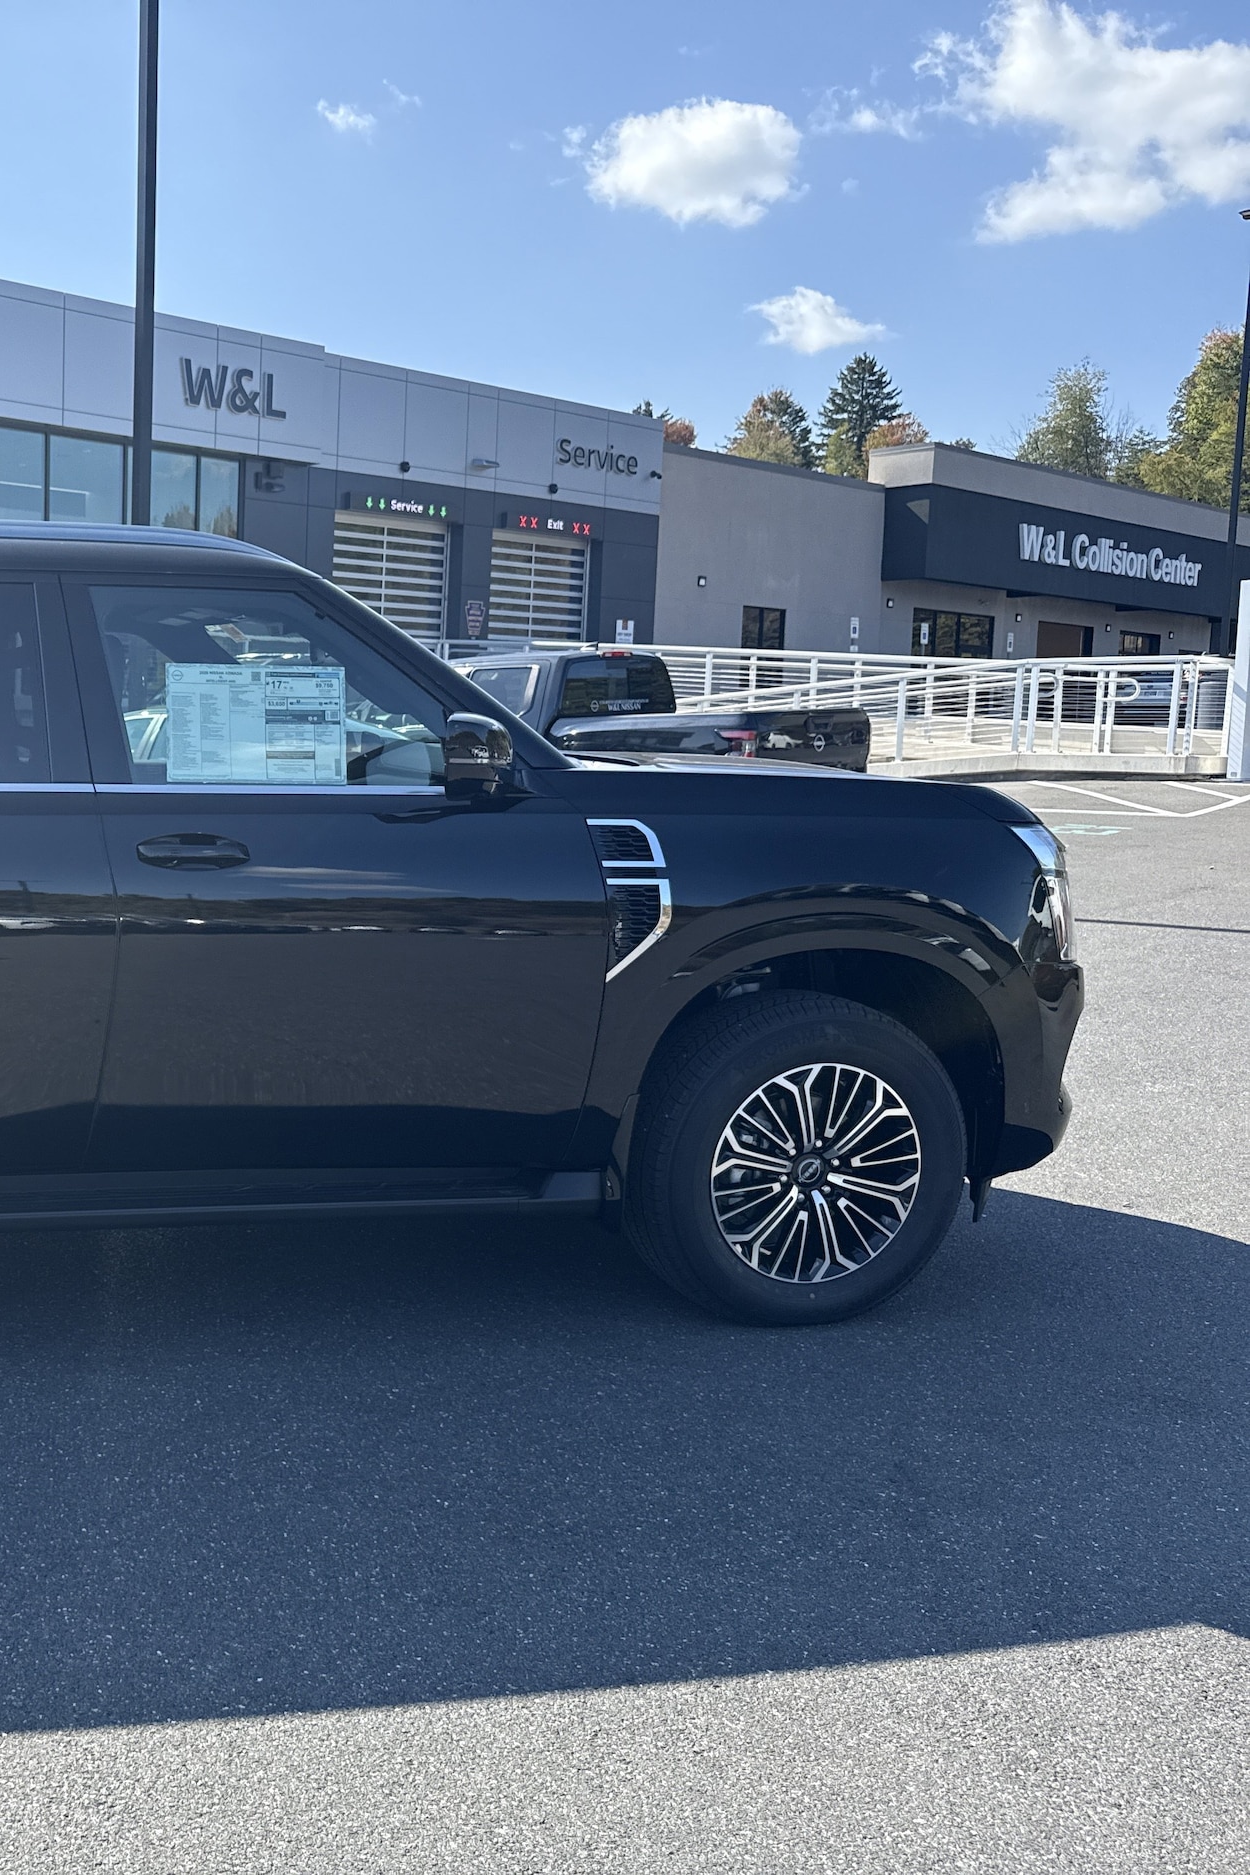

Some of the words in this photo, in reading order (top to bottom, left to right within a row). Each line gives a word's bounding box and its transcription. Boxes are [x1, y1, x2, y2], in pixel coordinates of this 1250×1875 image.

[180, 357, 286, 420] W&L
[556, 438, 638, 475] Service
[390, 500, 424, 514] Service
[547, 518, 564, 530] Exit
[1019, 523, 1070, 567] W&L
[1072, 533, 1147, 579] Collision
[1148, 548, 1202, 587] Center
[271, 680, 282, 689] 17
